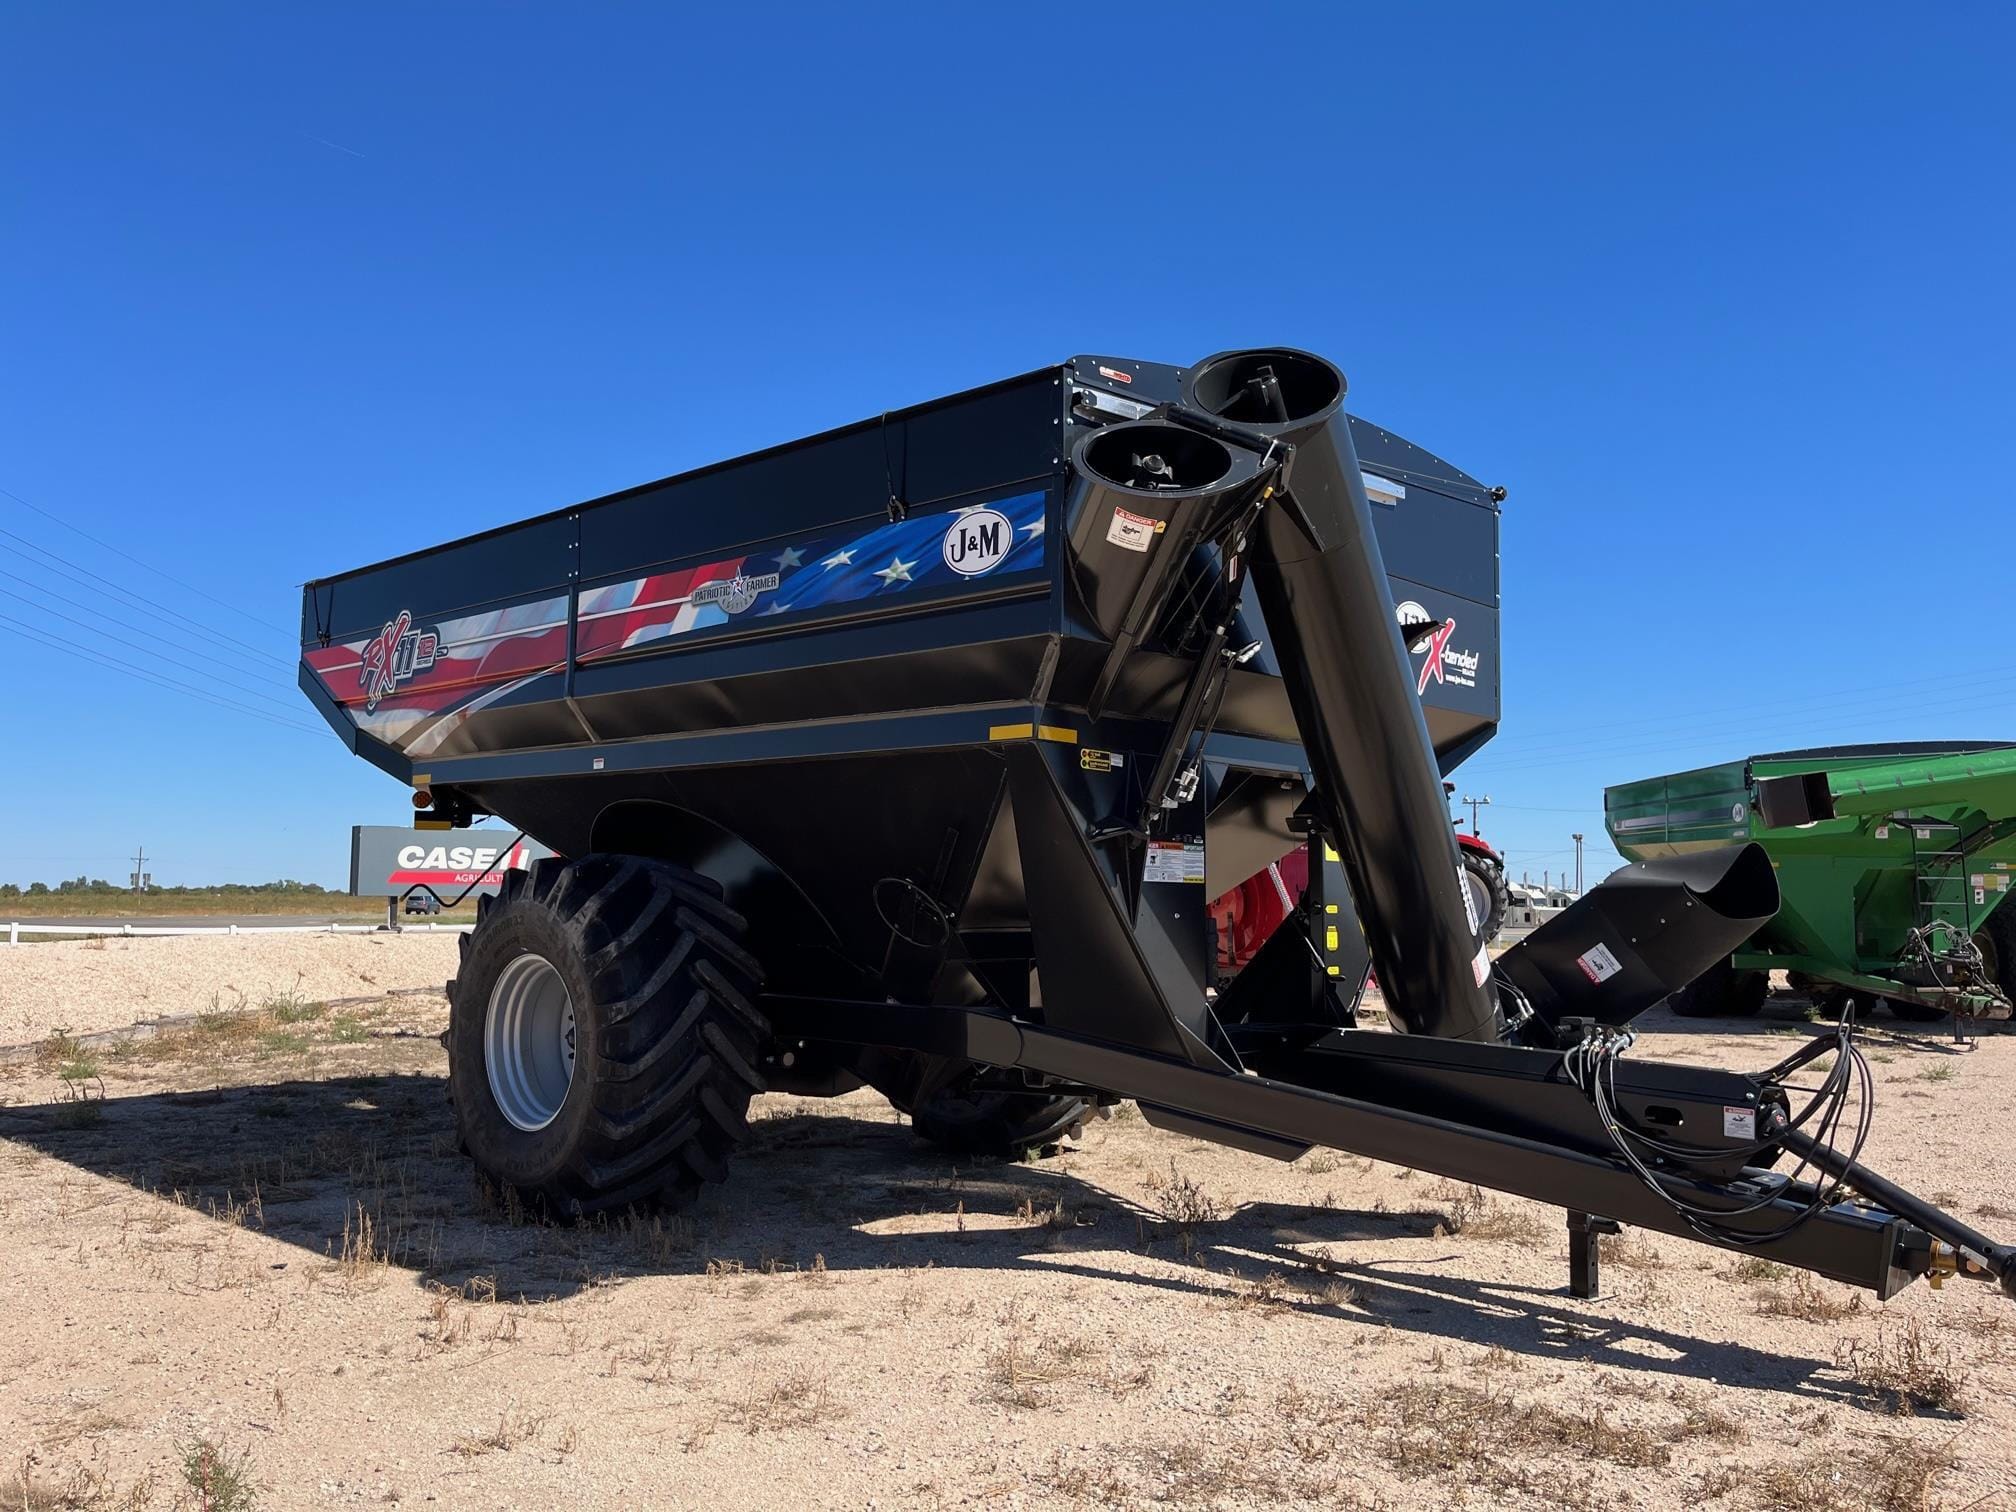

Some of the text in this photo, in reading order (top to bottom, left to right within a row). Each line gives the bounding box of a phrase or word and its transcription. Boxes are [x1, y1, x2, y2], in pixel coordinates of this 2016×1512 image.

[1125, 513, 1153, 526] DANGER
[950, 521, 1000, 563] J&M
[694, 575, 777, 601] PATRIOTIC FARMER
[397, 845, 498, 870] CASE
[454, 873, 504, 883] AGRICULT
